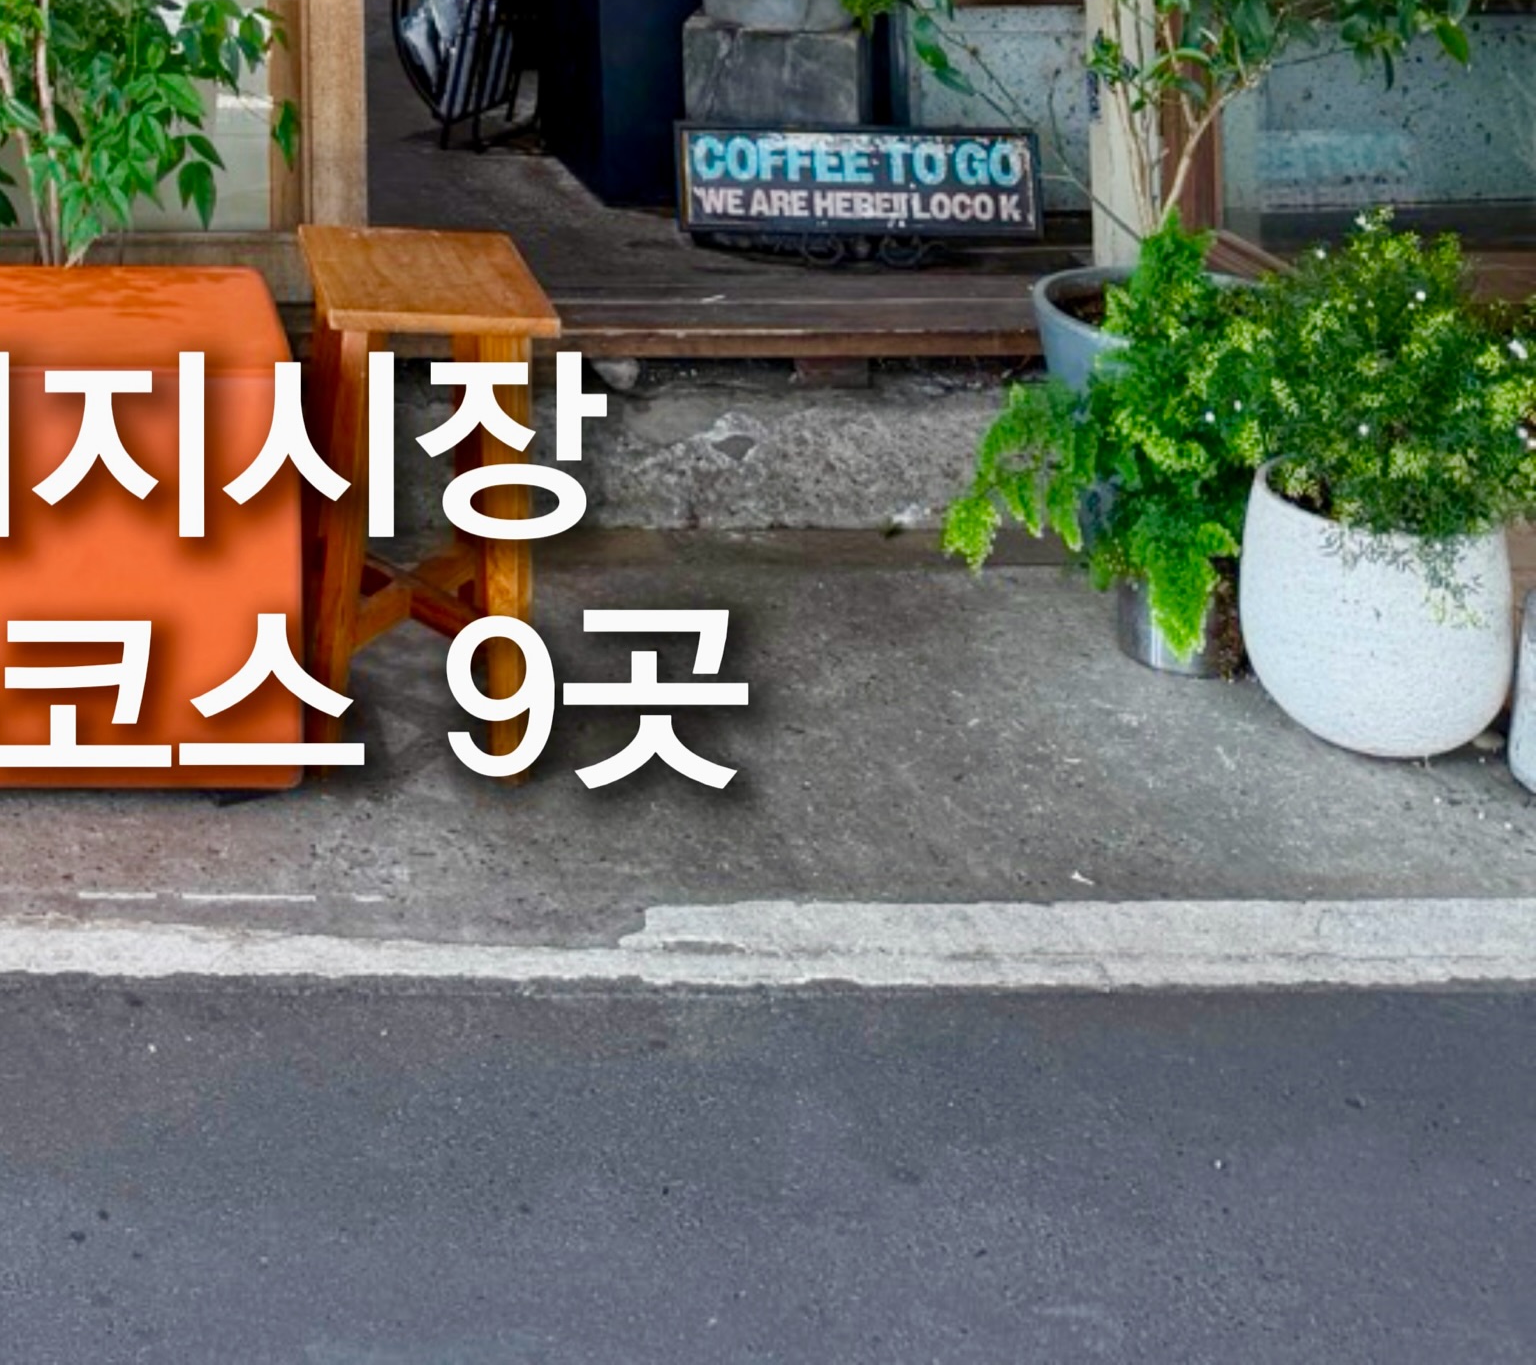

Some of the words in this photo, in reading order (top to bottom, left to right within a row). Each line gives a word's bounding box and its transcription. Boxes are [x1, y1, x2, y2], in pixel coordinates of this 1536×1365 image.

[692, 135, 874, 185] COFFEE
[881, 141, 948, 187] TO
[954, 141, 1024, 188] GO
[749, 189, 808, 218] ARE
